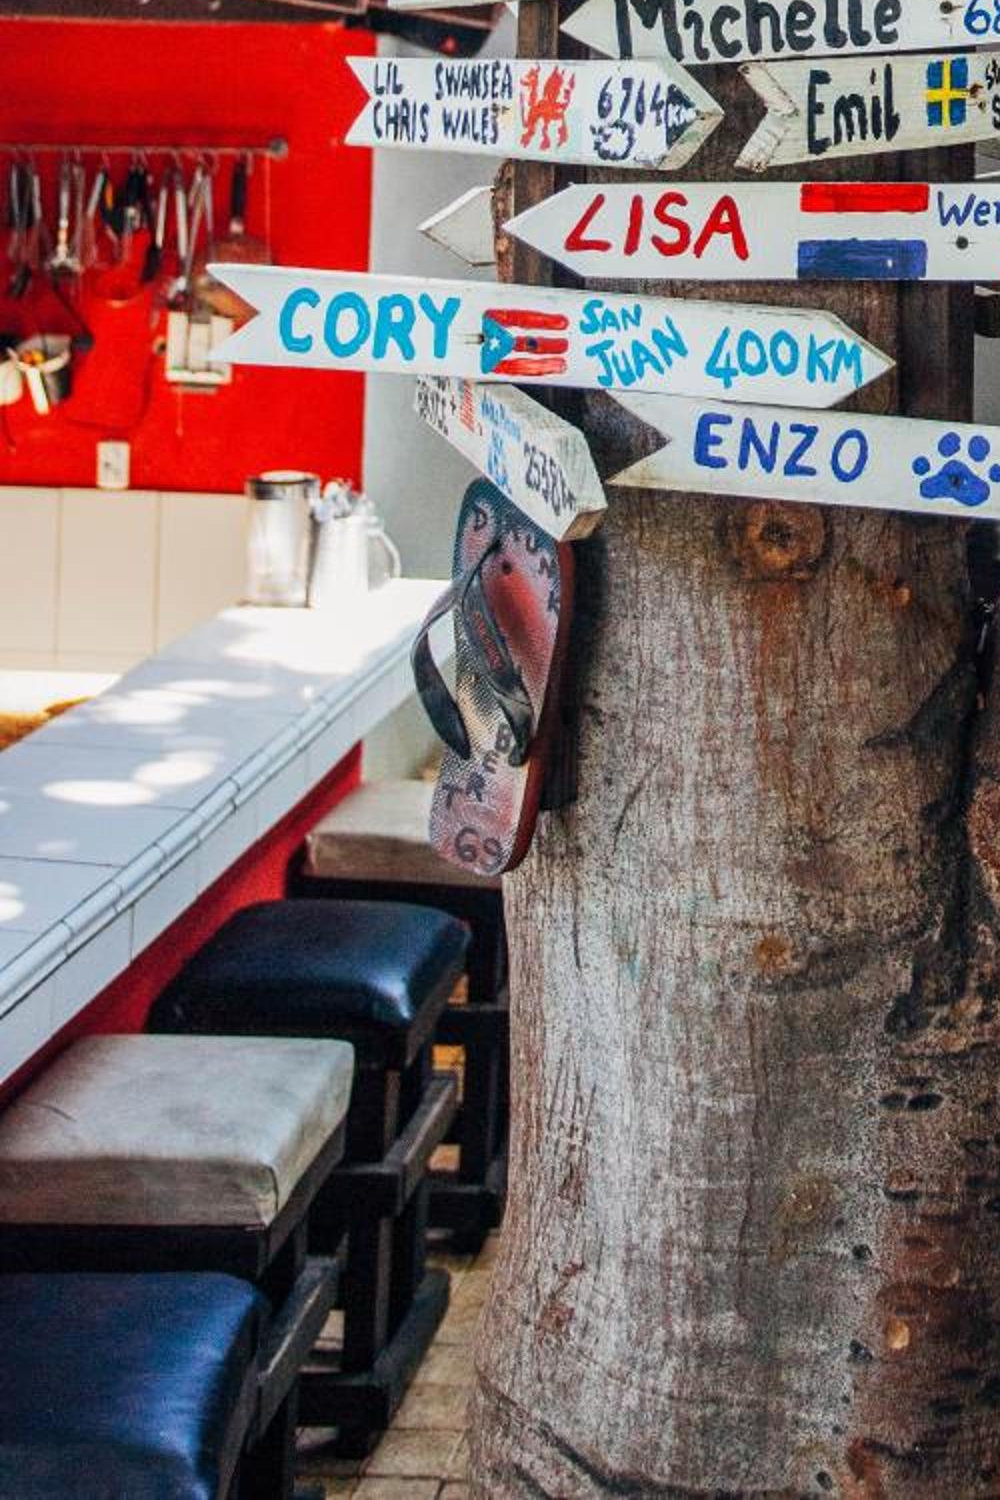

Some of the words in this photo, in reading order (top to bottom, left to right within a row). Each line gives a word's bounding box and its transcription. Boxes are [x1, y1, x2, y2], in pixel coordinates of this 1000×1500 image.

[374, 62, 403, 96] LIL
[434, 60, 513, 100] SWANSEA
[807, 62, 901, 155] Emil
[373, 97, 429, 142] CHRIS
[442, 102, 499, 145] WALES
[564, 191, 749, 261] LISA
[279, 287, 461, 362] CORY
[579, 300, 642, 335] SAN
[586, 316, 690, 389] JUAN
[693, 412, 870, 484] ENZO
